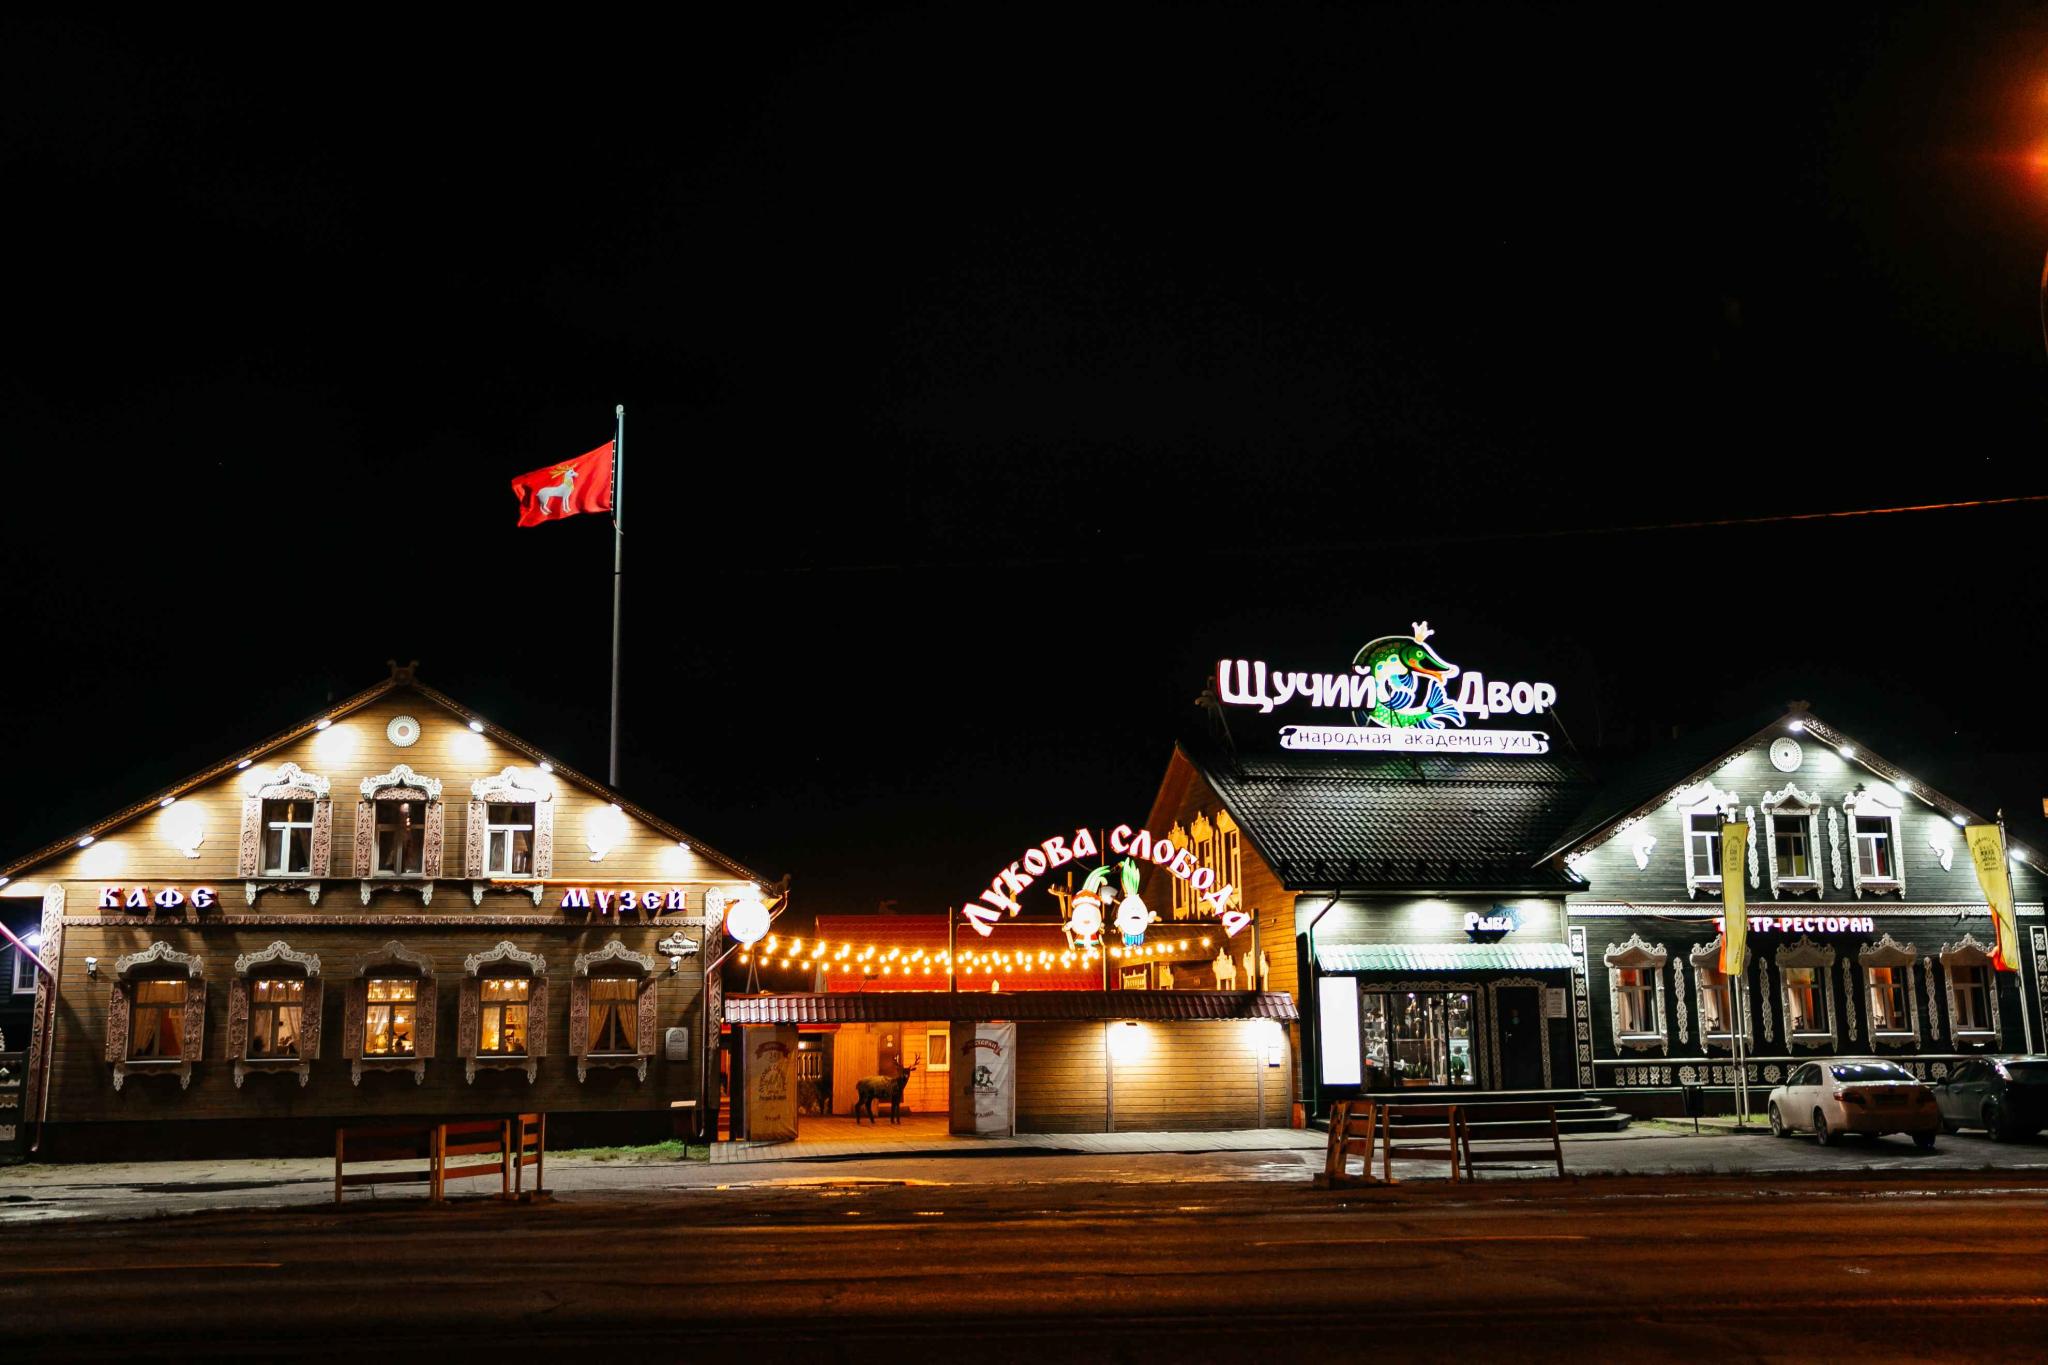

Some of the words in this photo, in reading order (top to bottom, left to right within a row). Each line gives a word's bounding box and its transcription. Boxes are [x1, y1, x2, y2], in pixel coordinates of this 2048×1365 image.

[1298, 731, 1392, 747] народная
[1404, 734, 1493, 748] академия
[1499, 736, 1532, 751] ухи
[97, 886, 216, 909] КАФЕ
[560, 887, 688, 915] МУЗЕЙ
